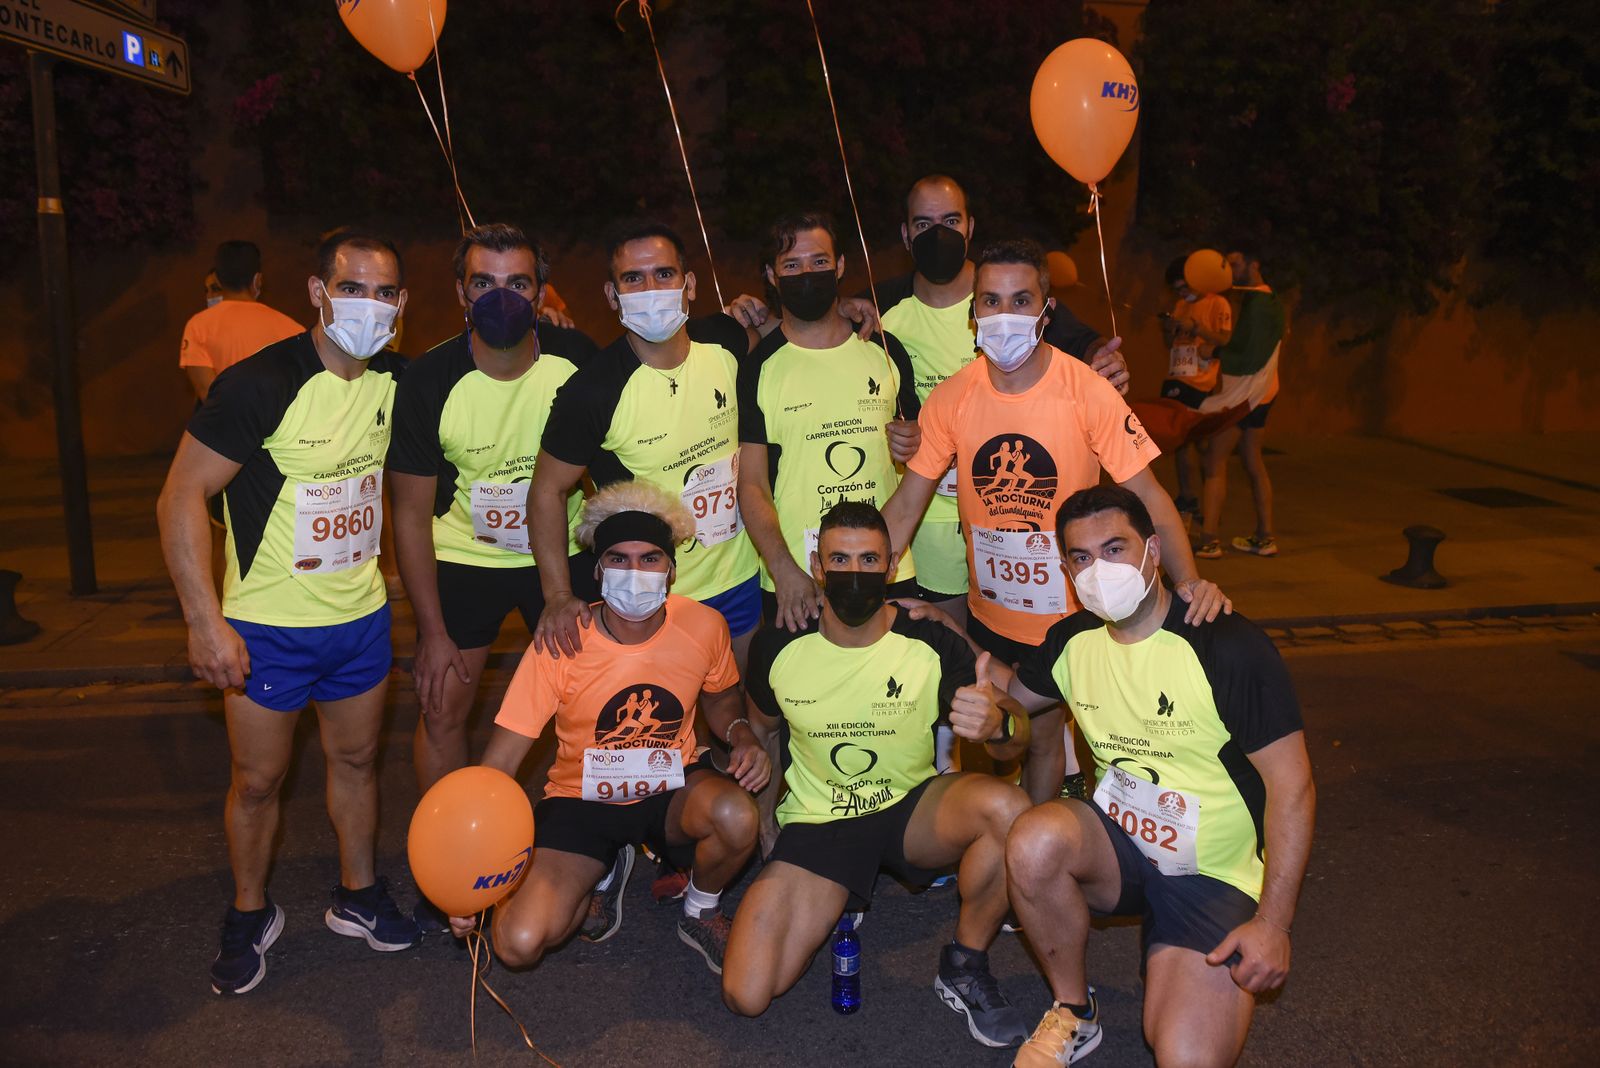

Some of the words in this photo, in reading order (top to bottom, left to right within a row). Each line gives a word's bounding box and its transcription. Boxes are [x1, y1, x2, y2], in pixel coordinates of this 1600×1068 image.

[833, 418, 863, 429] EDICIÓN
[805, 430, 841, 441] CARRERA
[841, 426, 879, 436] NOCTURNA
[662, 454, 697, 472] CARRERA
[697, 437, 730, 458] NOCTURNA
[679, 449, 690, 458] XIII
[690, 436, 716, 453] EDICIÓN
[336, 461, 347, 470] XIII
[347, 453, 373, 467] EDICIÓN
[505, 459, 516, 467] XIII
[313, 468, 353, 480] CARRERA
[488, 465, 524, 479] CARRERA
[817, 482, 863, 495] Corazón
[864, 480, 876, 489] de
[693, 486, 735, 519] 973
[982, 498, 993, 507] LA
[995, 493, 1051, 510] NOCTURNA
[988, 506, 998, 517] del
[998, 505, 1045, 520] Guadalquivir
[312, 505, 374, 542] 9860
[986, 556, 1050, 585] 1395
[841, 721, 876, 730] EDICIÓN
[807, 730, 848, 739] CARRERA
[850, 729, 896, 738] NOCTURNA
[1108, 733, 1120, 742] XIII
[1119, 736, 1151, 747] EDICIÓN
[596, 780, 668, 800] 9184
[826, 777, 873, 792] Corazón
[875, 777, 892, 786] de
[831, 787, 847, 804] Los
[1107, 802, 1178, 853] 8082
